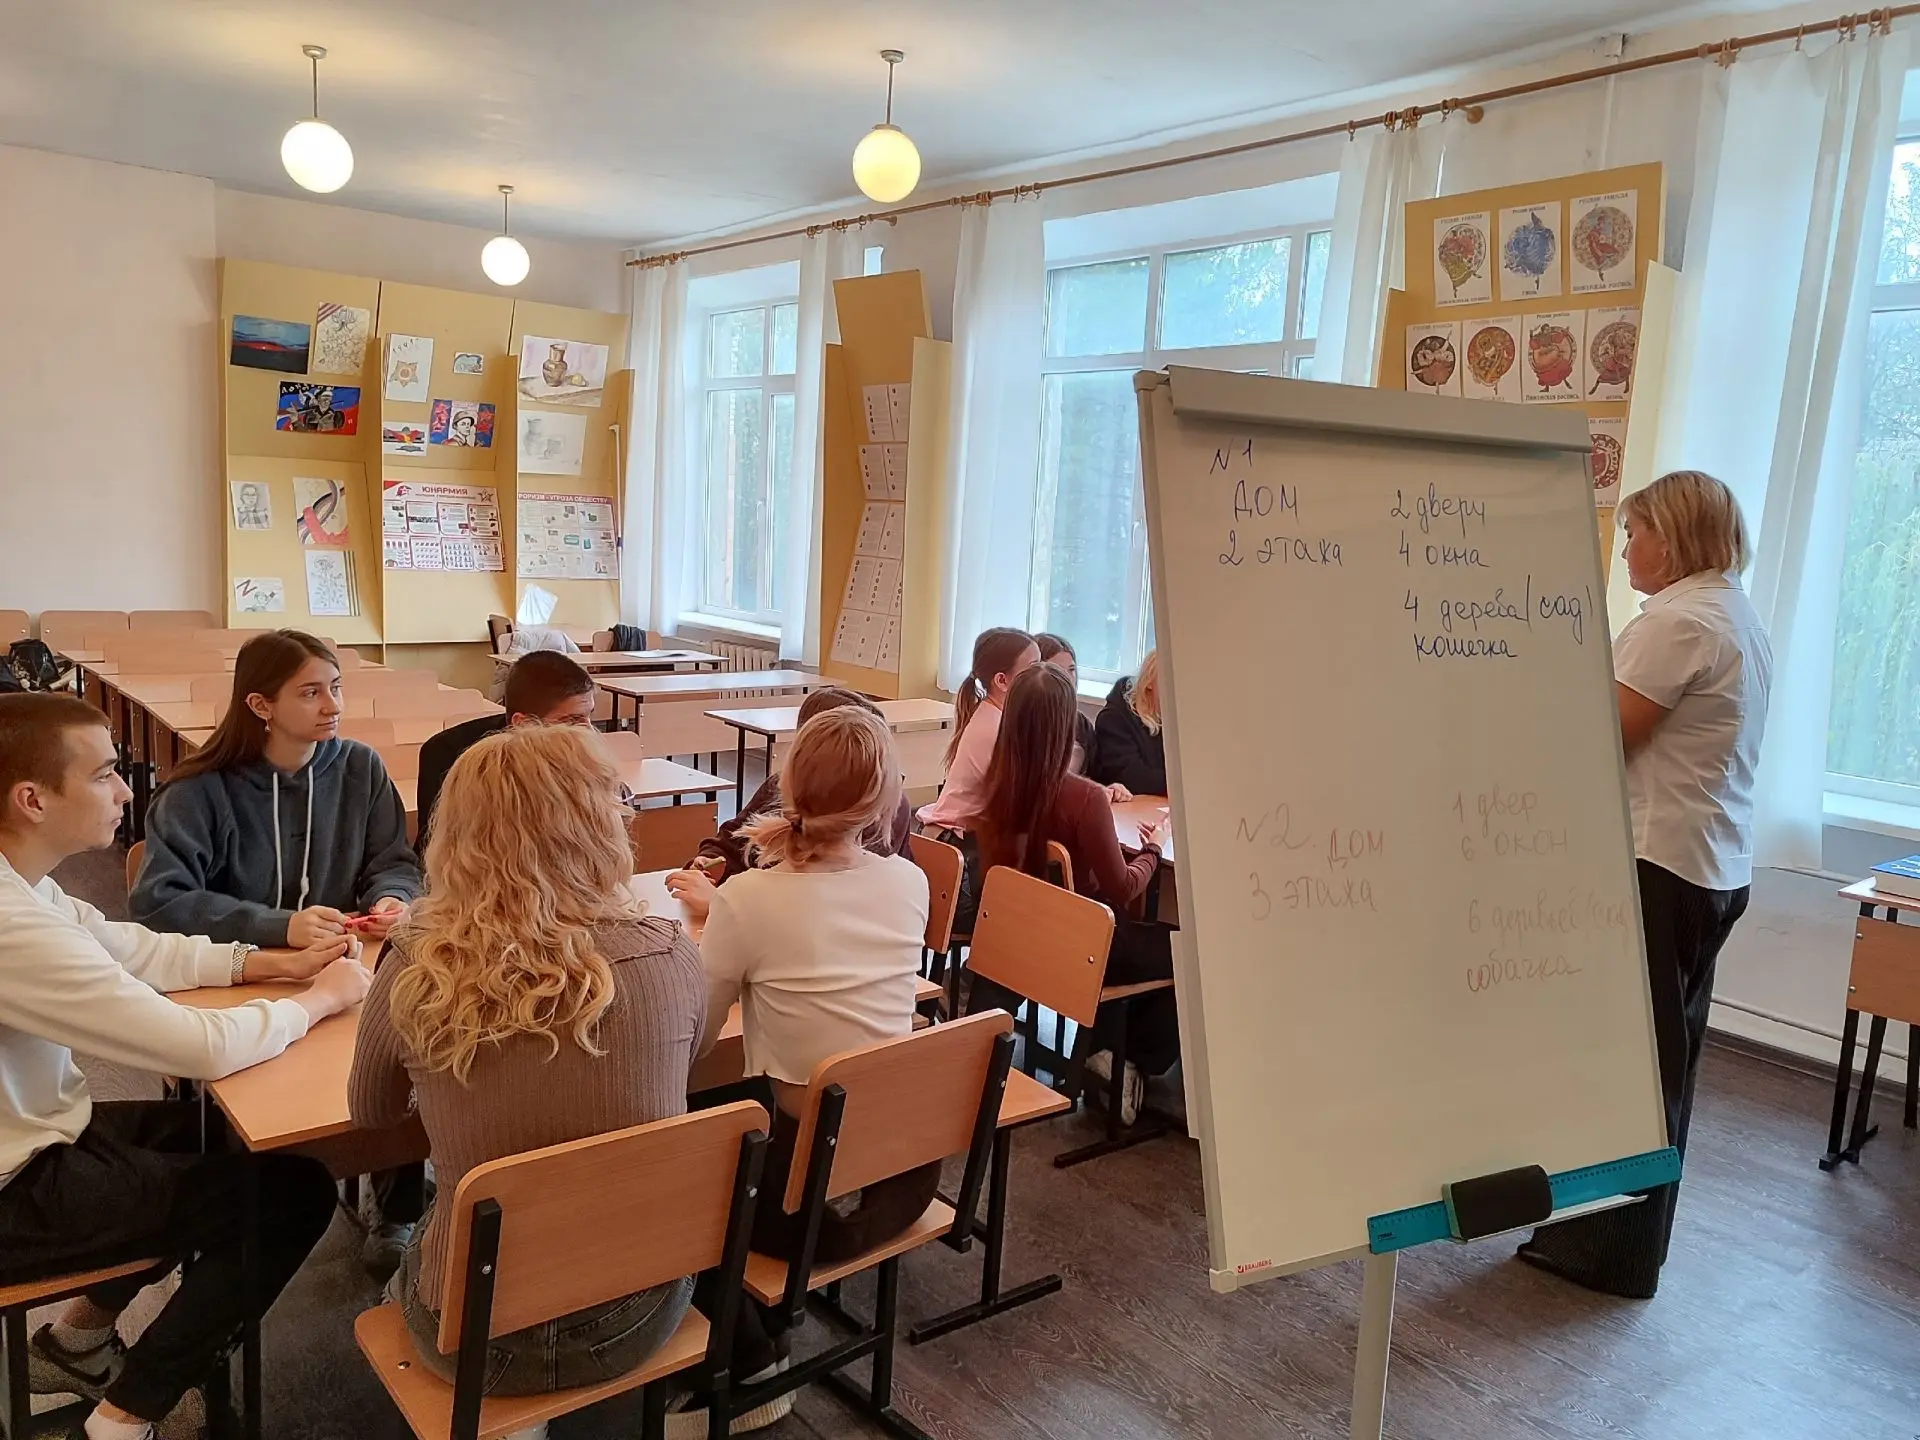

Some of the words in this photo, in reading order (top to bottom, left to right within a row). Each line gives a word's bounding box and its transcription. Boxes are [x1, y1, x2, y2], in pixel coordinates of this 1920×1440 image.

[422, 485, 468, 496] ЮНАРМИЯ
[1218, 529, 1245, 567] 2
[1256, 536, 1343, 568] этажа
[1399, 529, 1410, 567] 4
[1425, 544, 1491, 568] окна
[1404, 588, 1419, 623] 4
[1413, 633, 1519, 663] кошечка
[1452, 790, 1464, 824] 1
[1461, 834, 1476, 862] 6
[1249, 871, 1272, 921] 3
[1468, 897, 1481, 934] 6
